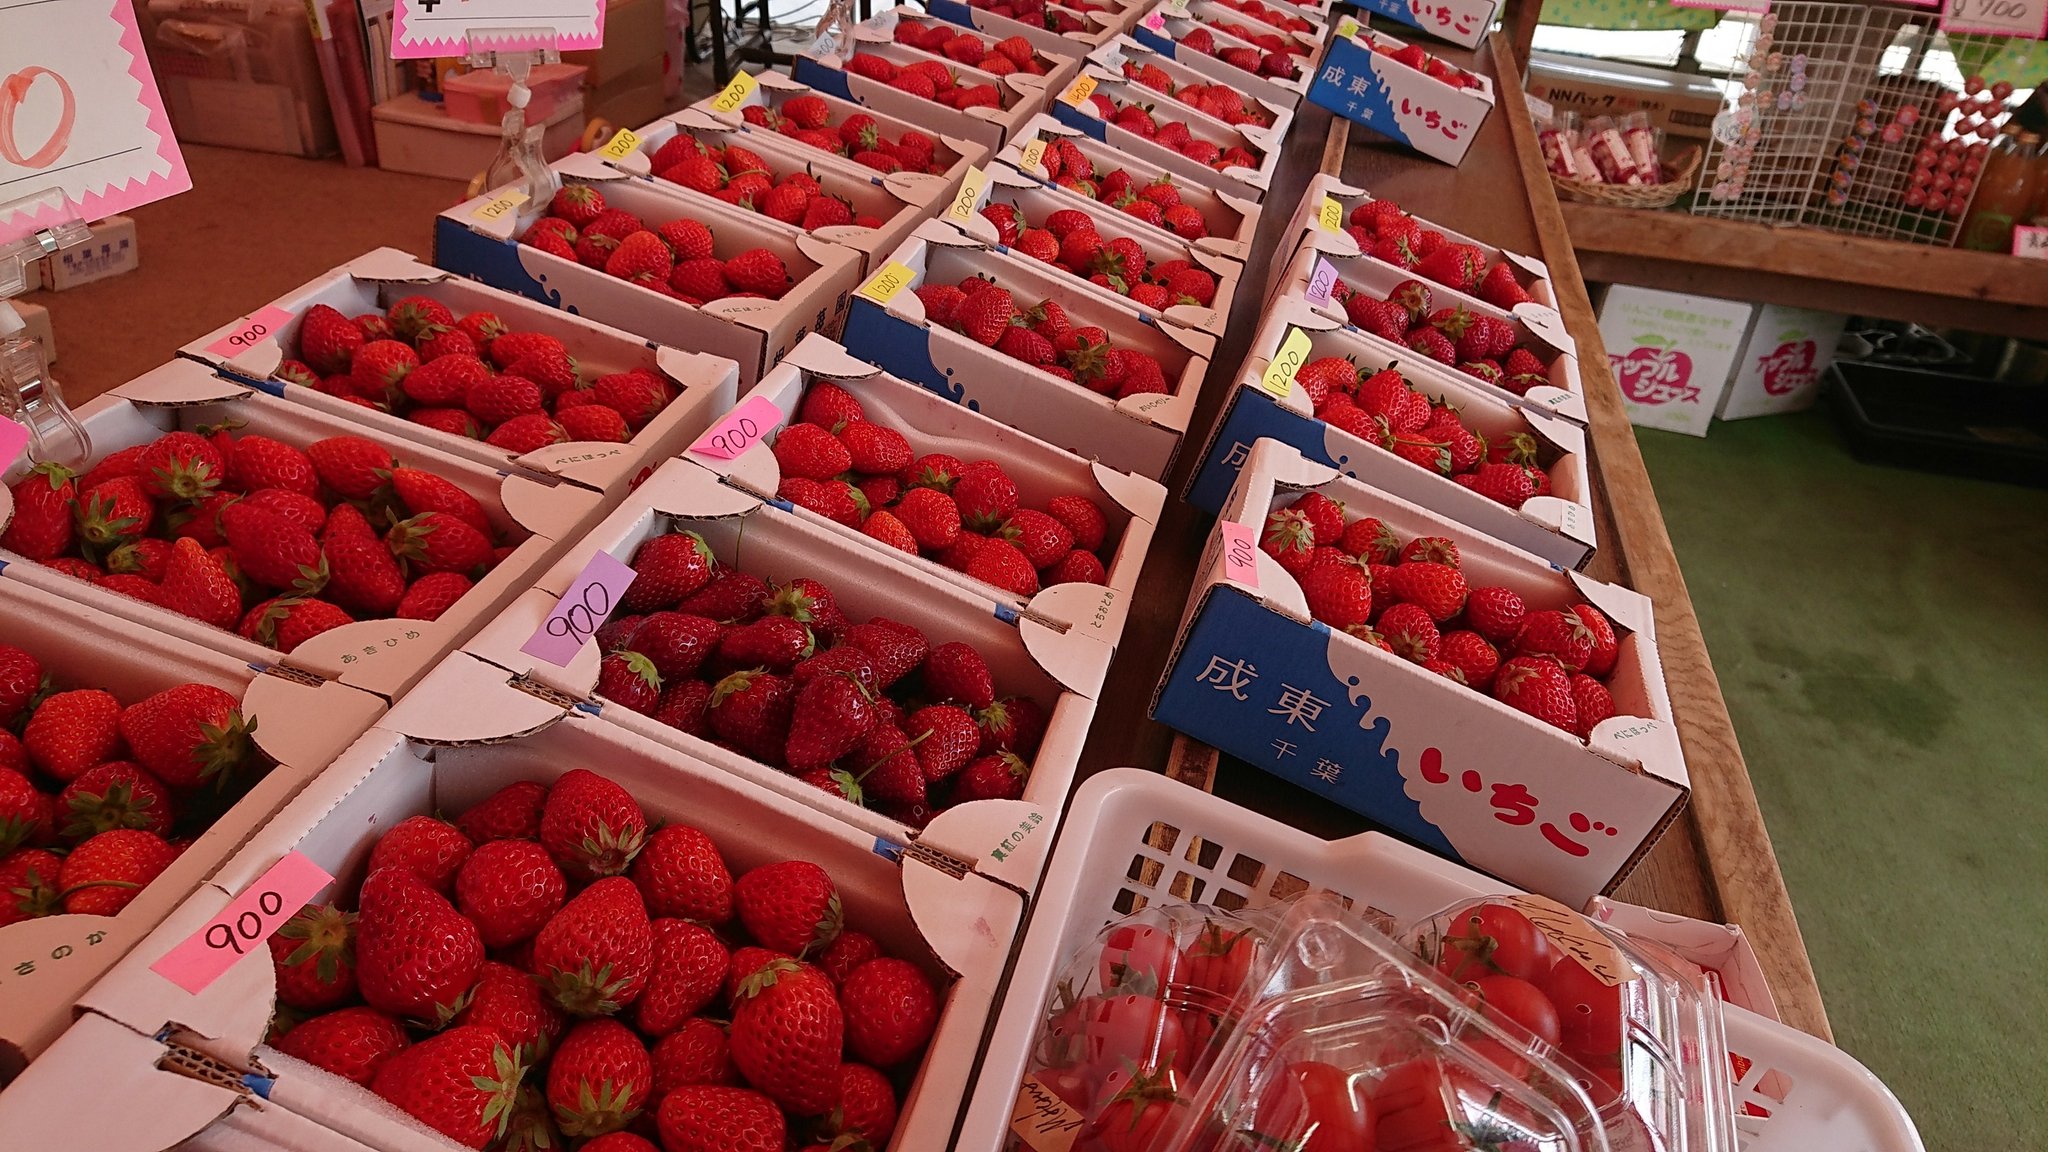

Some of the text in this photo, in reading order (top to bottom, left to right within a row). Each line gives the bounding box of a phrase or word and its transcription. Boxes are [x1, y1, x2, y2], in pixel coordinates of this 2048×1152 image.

[1321, 65, 1371, 97] 成東
[717, 83, 745, 112] 1200
[1346, 100, 1375, 121] 千葉
[1400, 97, 1468, 141] いちご
[608, 132, 636, 158] 1200
[482, 199, 513, 219] 1200
[955, 187, 976, 218] 1200
[872, 273, 900, 296] 1200
[1309, 270, 1330, 301] 1200
[229, 324, 267, 347] 900
[1269, 350, 1299, 392] 1200
[711, 418, 758, 455] 900
[1228, 538, 1254, 568] 900
[547, 581, 610, 646] 900
[340, 630, 421, 665] あきひめ
[1196, 652, 1333, 734] 成東
[1269, 737, 1346, 786] 千葉
[1419, 747, 1618, 858] いちご
[205, 890, 283, 954] 900
